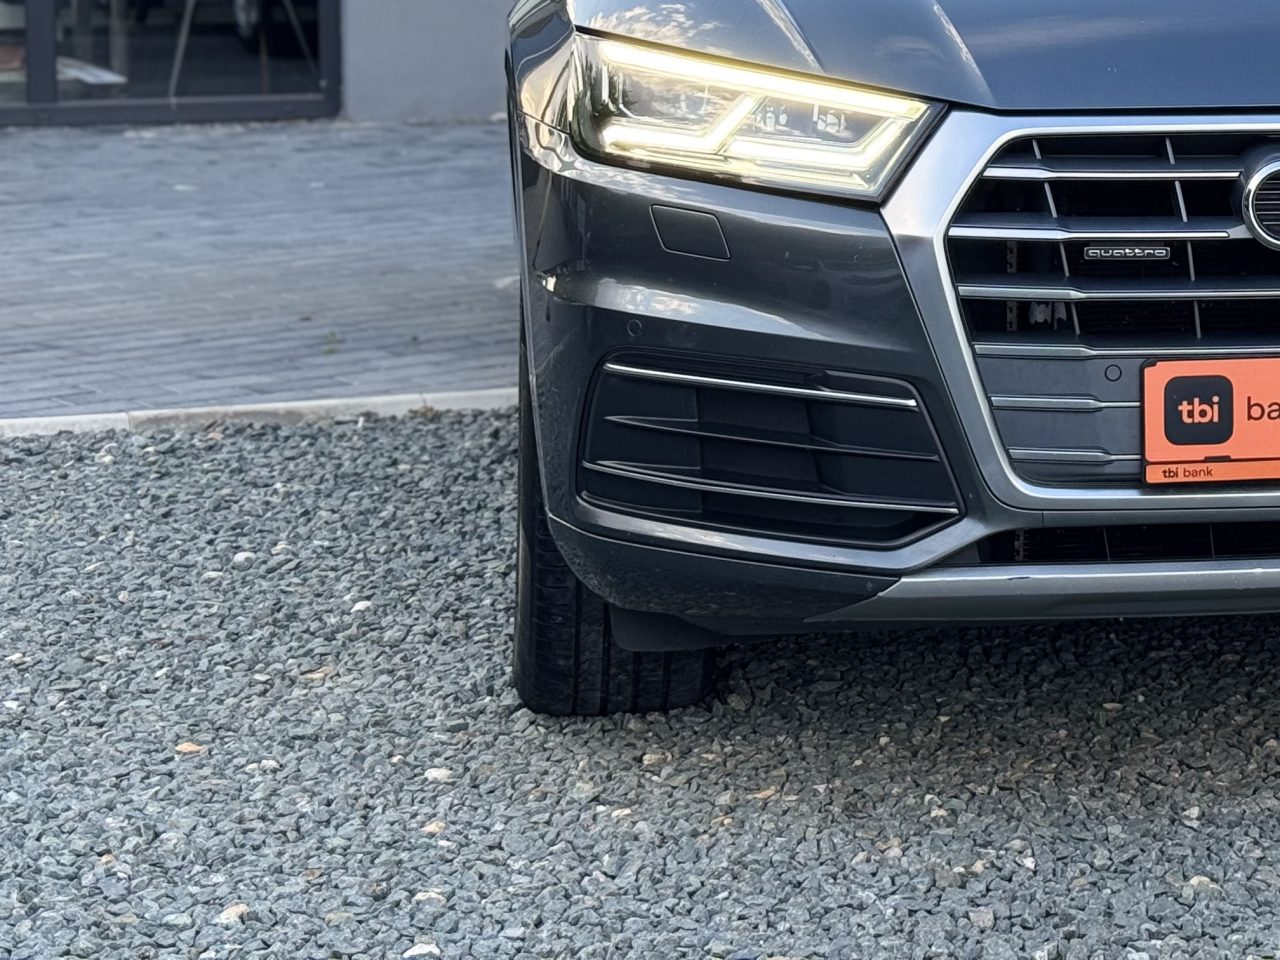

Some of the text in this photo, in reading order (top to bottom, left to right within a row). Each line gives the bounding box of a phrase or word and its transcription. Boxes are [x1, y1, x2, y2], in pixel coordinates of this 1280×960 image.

[1088, 248, 1167, 258] quattro
[1178, 395, 1219, 424] tbi
[1162, 467, 1213, 479] tbi bank
